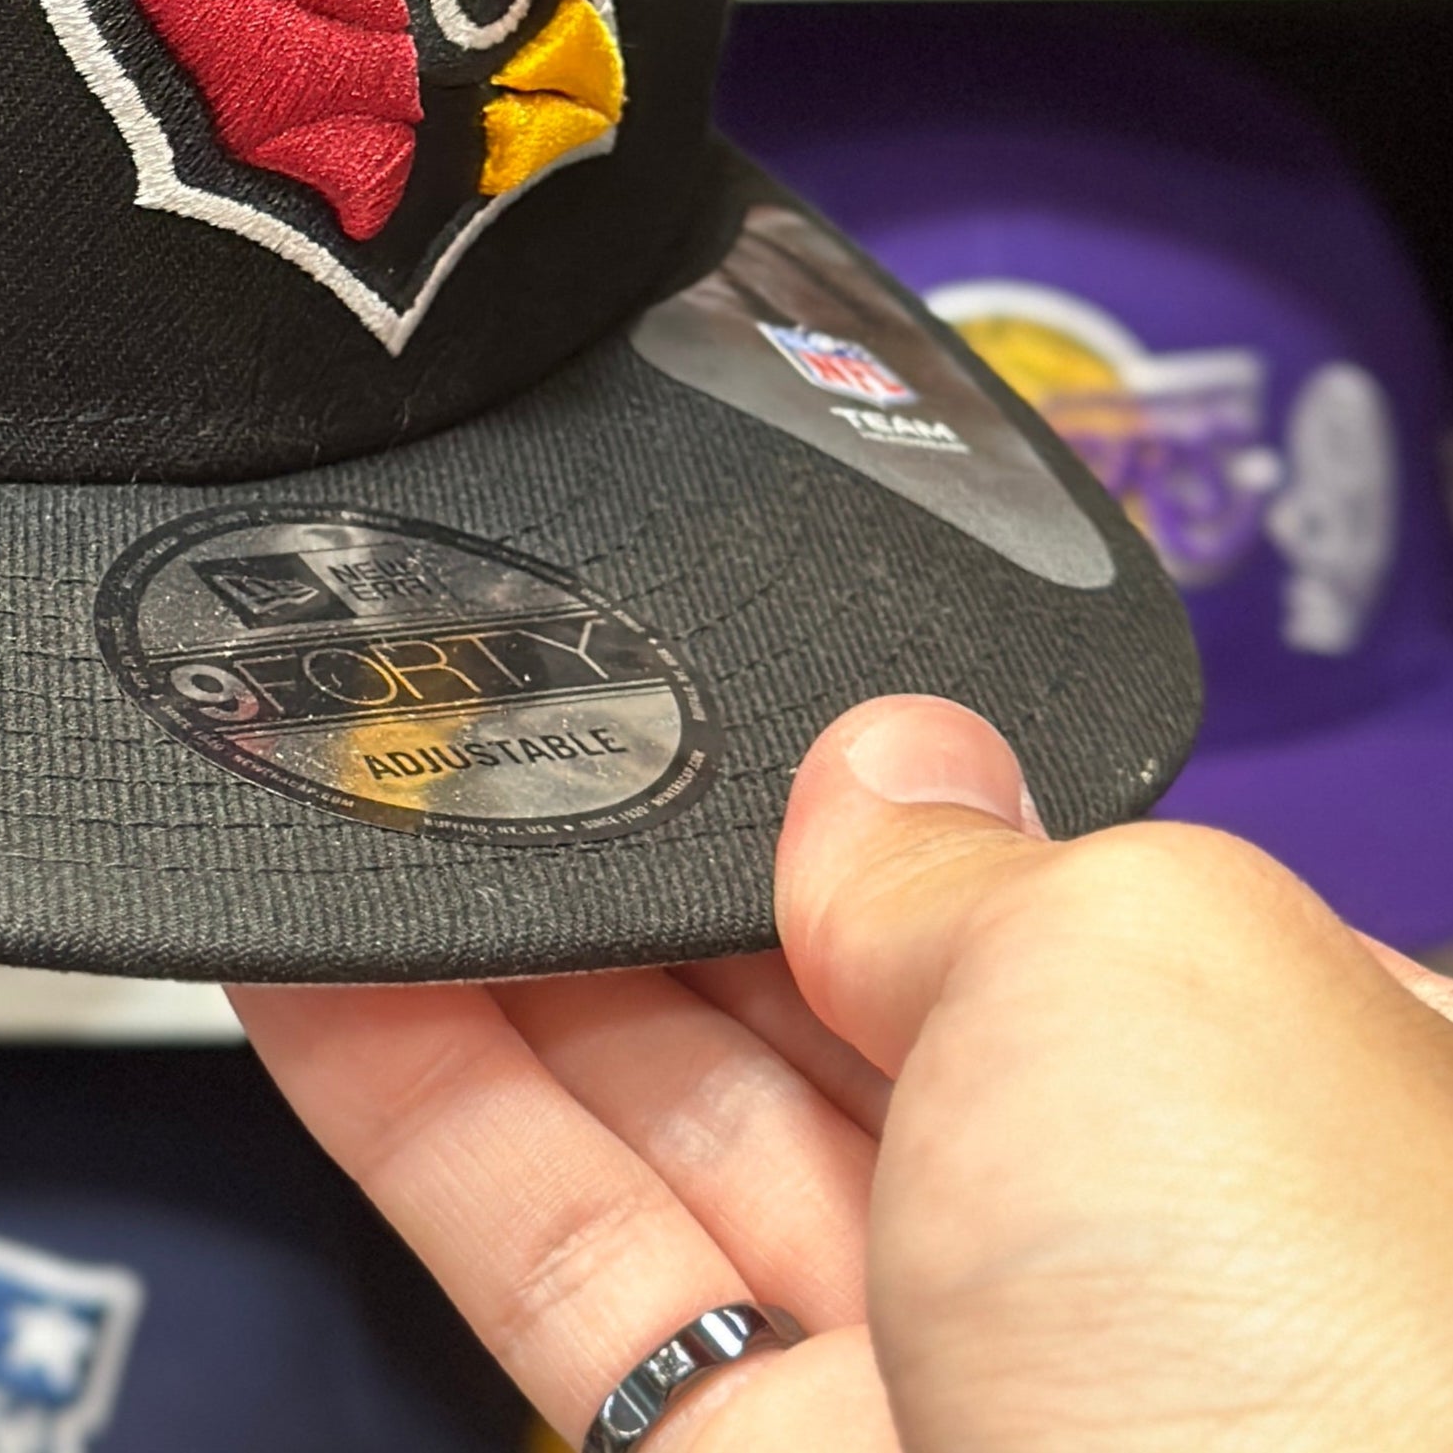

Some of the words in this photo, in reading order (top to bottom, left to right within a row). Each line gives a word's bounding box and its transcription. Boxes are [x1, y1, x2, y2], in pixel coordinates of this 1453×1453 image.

[829, 405, 957, 443] TEAM
[328, 557, 418, 584] NEW
[349, 574, 433, 602] ERA
[169, 617, 609, 722] 9FORTY
[363, 728, 628, 781] ADJUSTABLE
